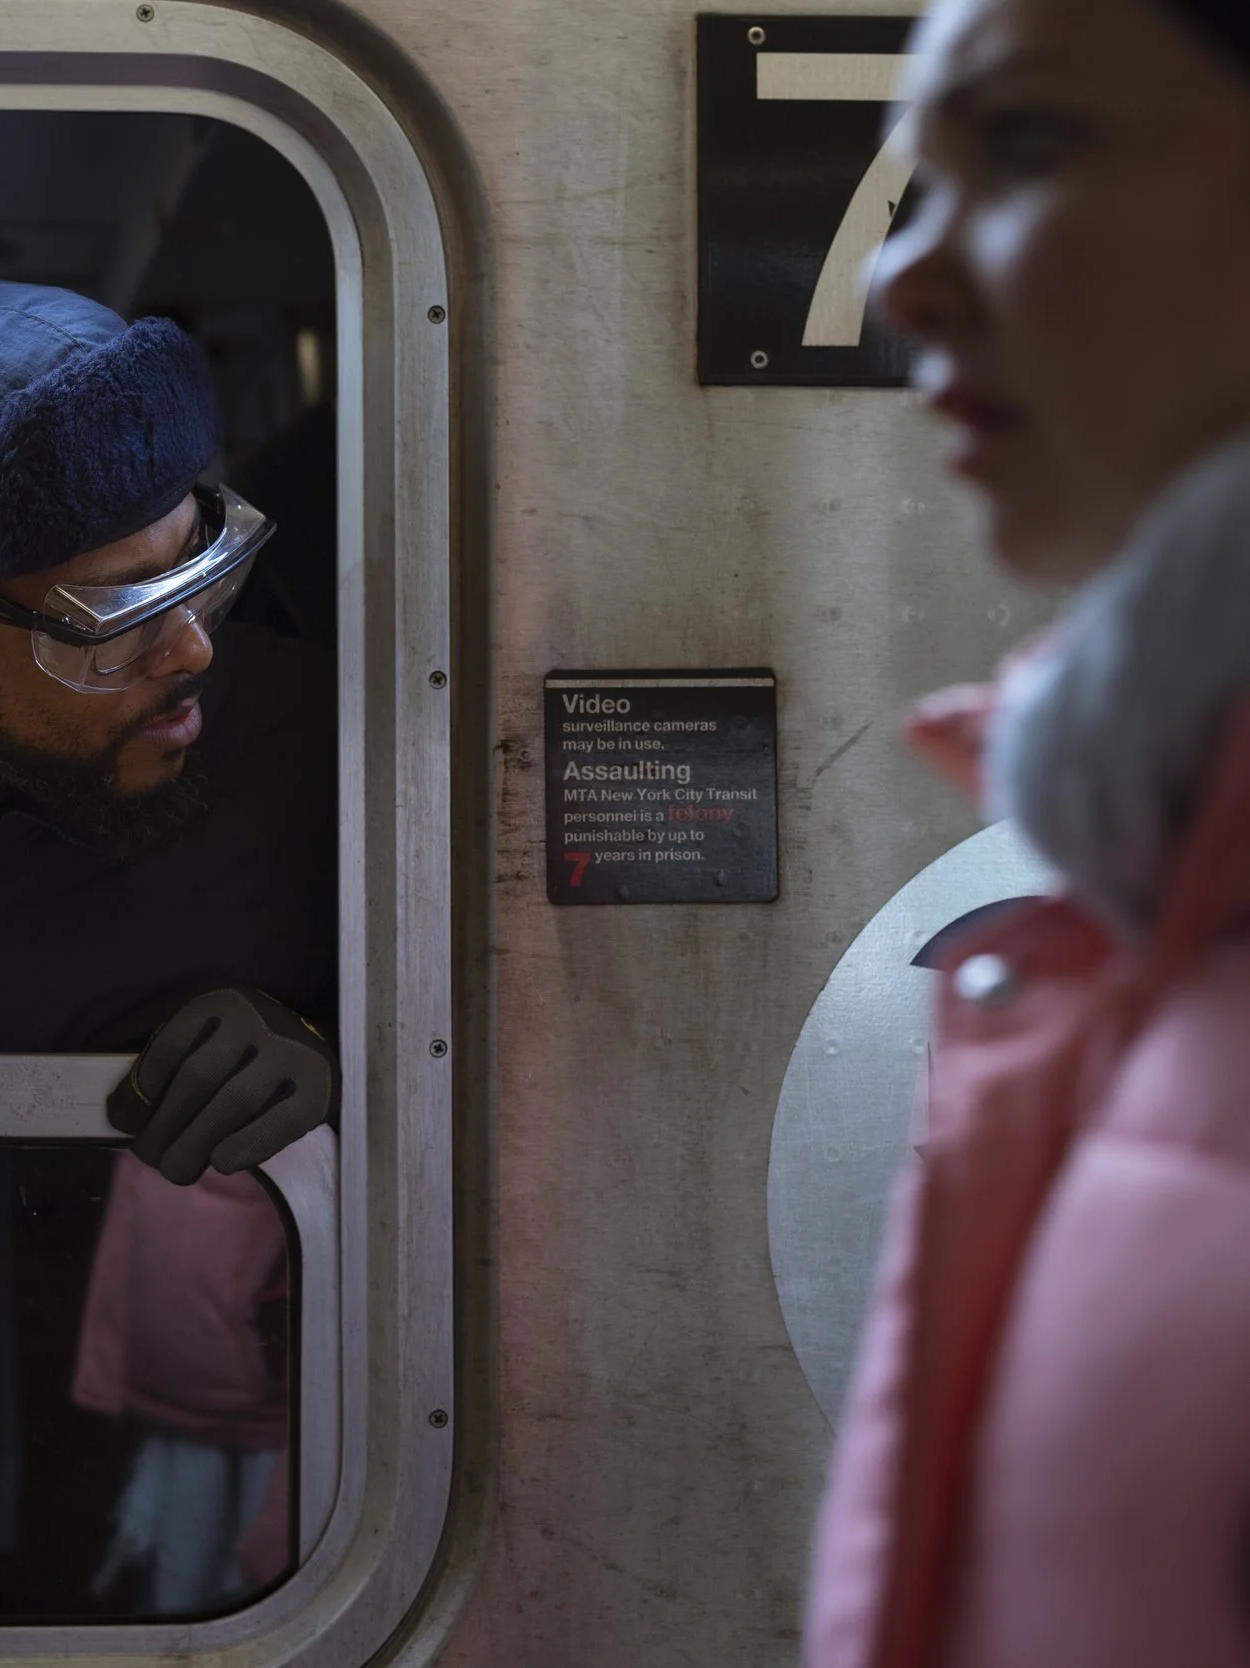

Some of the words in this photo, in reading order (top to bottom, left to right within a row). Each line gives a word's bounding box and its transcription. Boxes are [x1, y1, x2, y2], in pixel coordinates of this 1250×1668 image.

[756, 53, 928, 347] 7
[562, 693, 631, 714] Video
[562, 719, 650, 732] surveillance
[653, 721, 717, 732] cameras
[562, 740, 593, 753] may
[597, 738, 614, 751] be
[618, 738, 631, 751] in
[635, 740, 665, 751] use.
[563, 760, 691, 784] Assaulting
[564, 789, 597, 801] MTA
[601, 789, 633, 801] New
[637, 788, 670, 801] York
[675, 788, 703, 803] City
[706, 788, 757, 801] Transit
[564, 809, 637, 824] personnel
[641, 810, 652, 822] is
[655, 812, 664, 821] a
[668, 804, 734, 826] felony
[564, 829, 644, 844] punishable
[647, 829, 665, 844] by
[668, 831, 687, 844] up
[690, 830, 705, 841] to
[564, 850, 590, 886] 7
[595, 849, 635, 864] years
[638, 849, 652, 861] in
[655, 849, 705, 863] prison.
